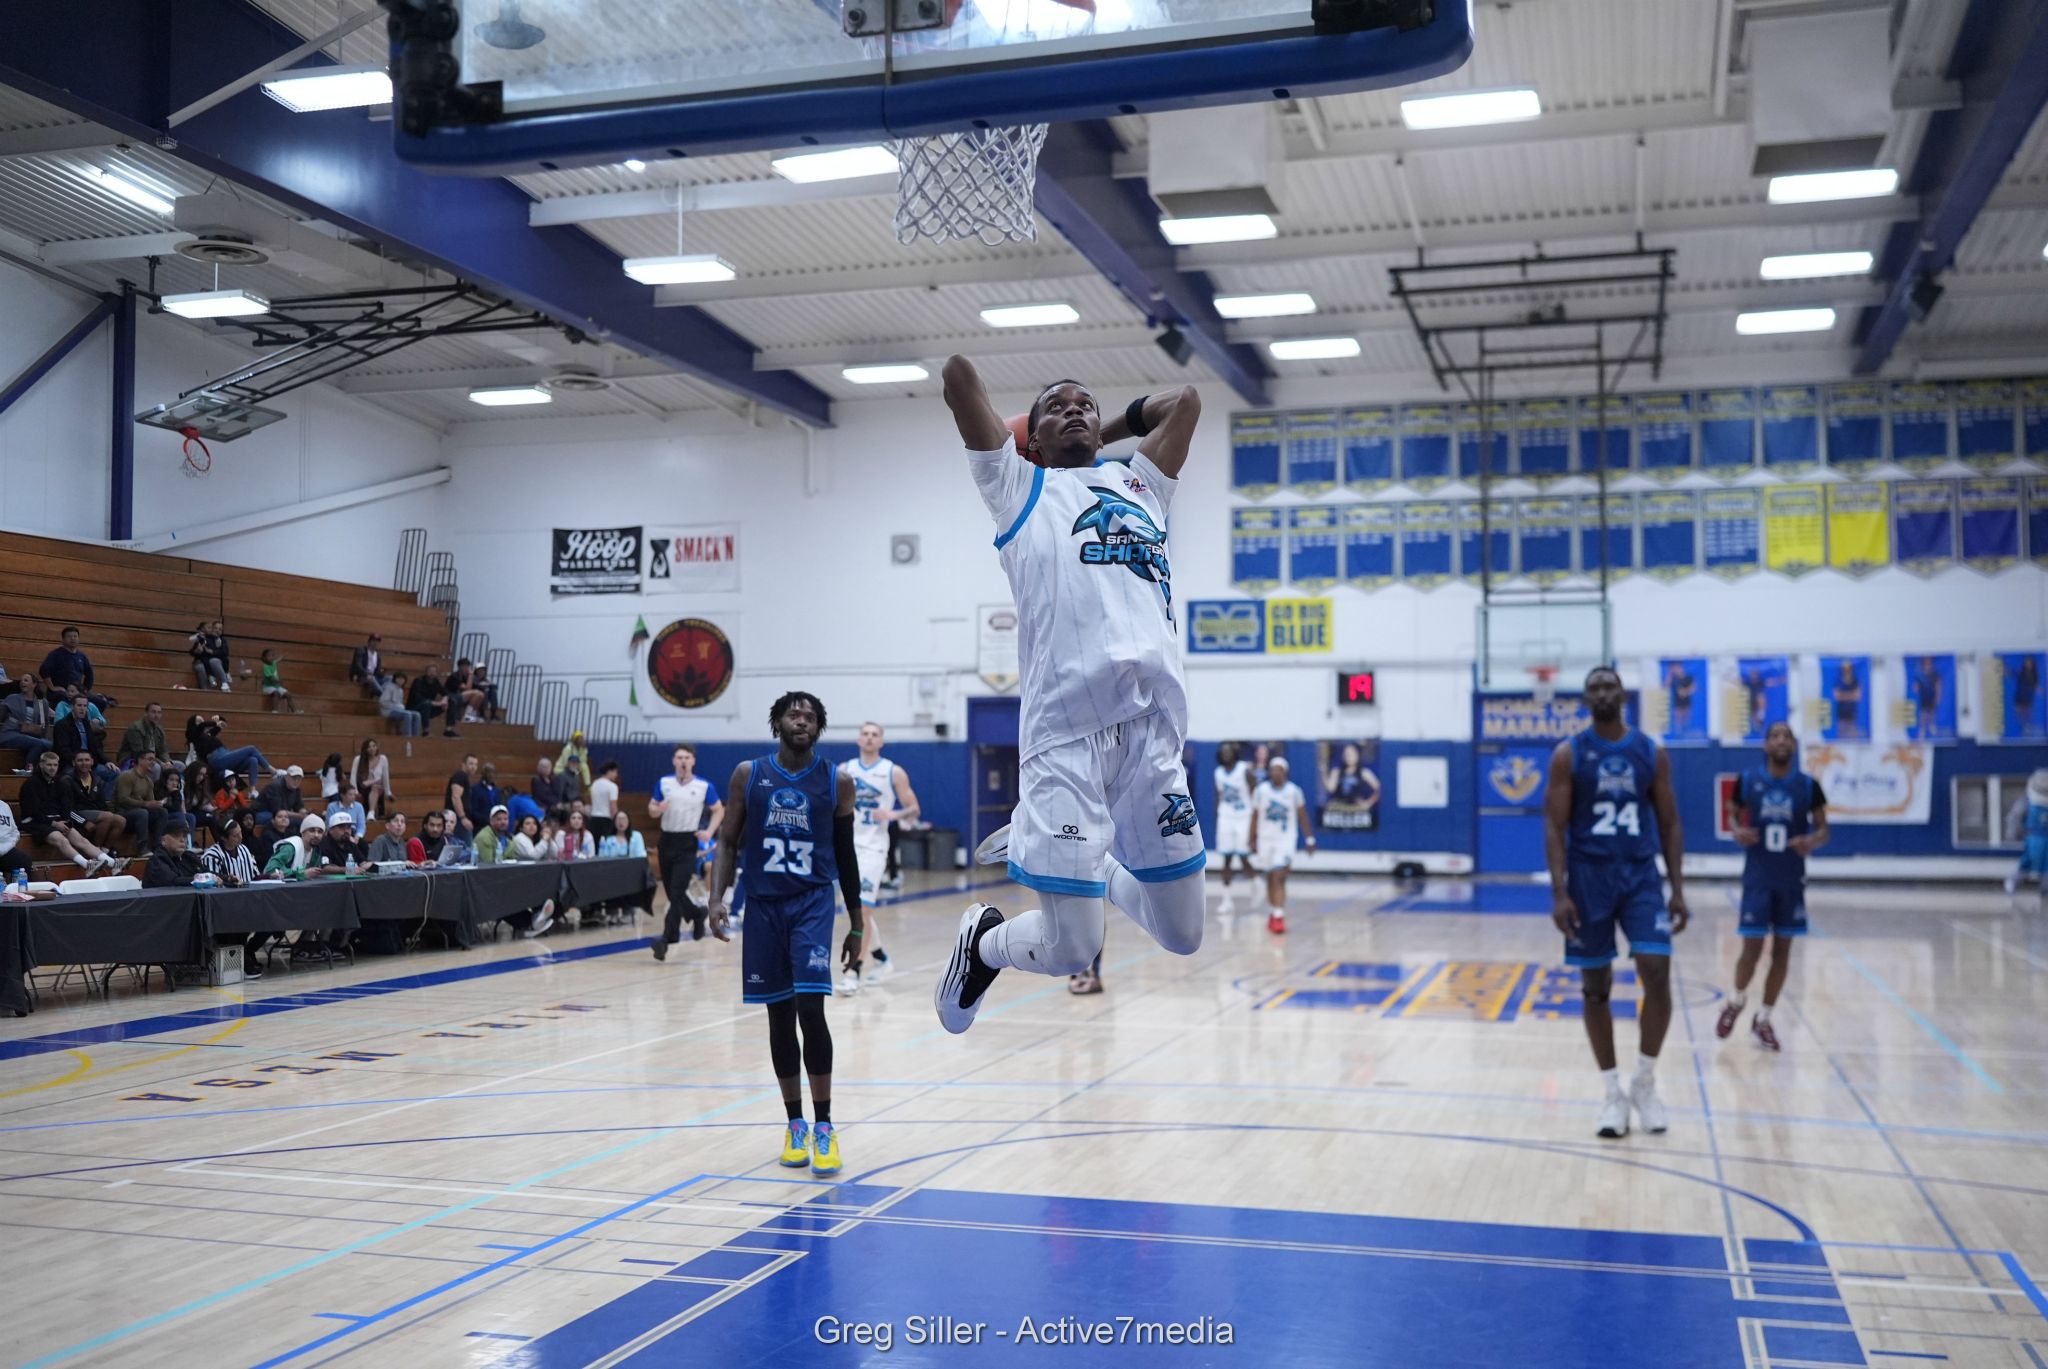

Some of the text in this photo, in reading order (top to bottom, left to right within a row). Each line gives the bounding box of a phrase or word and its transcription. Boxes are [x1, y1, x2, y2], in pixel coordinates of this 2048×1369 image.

[561, 531, 636, 571] Hoop
[674, 535, 734, 562] SMACK'N
[1106, 534, 1138, 544] SAN
[1272, 624, 1327, 647] BLUE
[1483, 699, 1546, 716] HOME
[1591, 801, 1640, 836] 24
[1053, 834, 1087, 842] WOOTER
[1765, 823, 1787, 852] 0
[763, 837, 814, 876] 23
[118, 1050, 404, 1103] MESA
